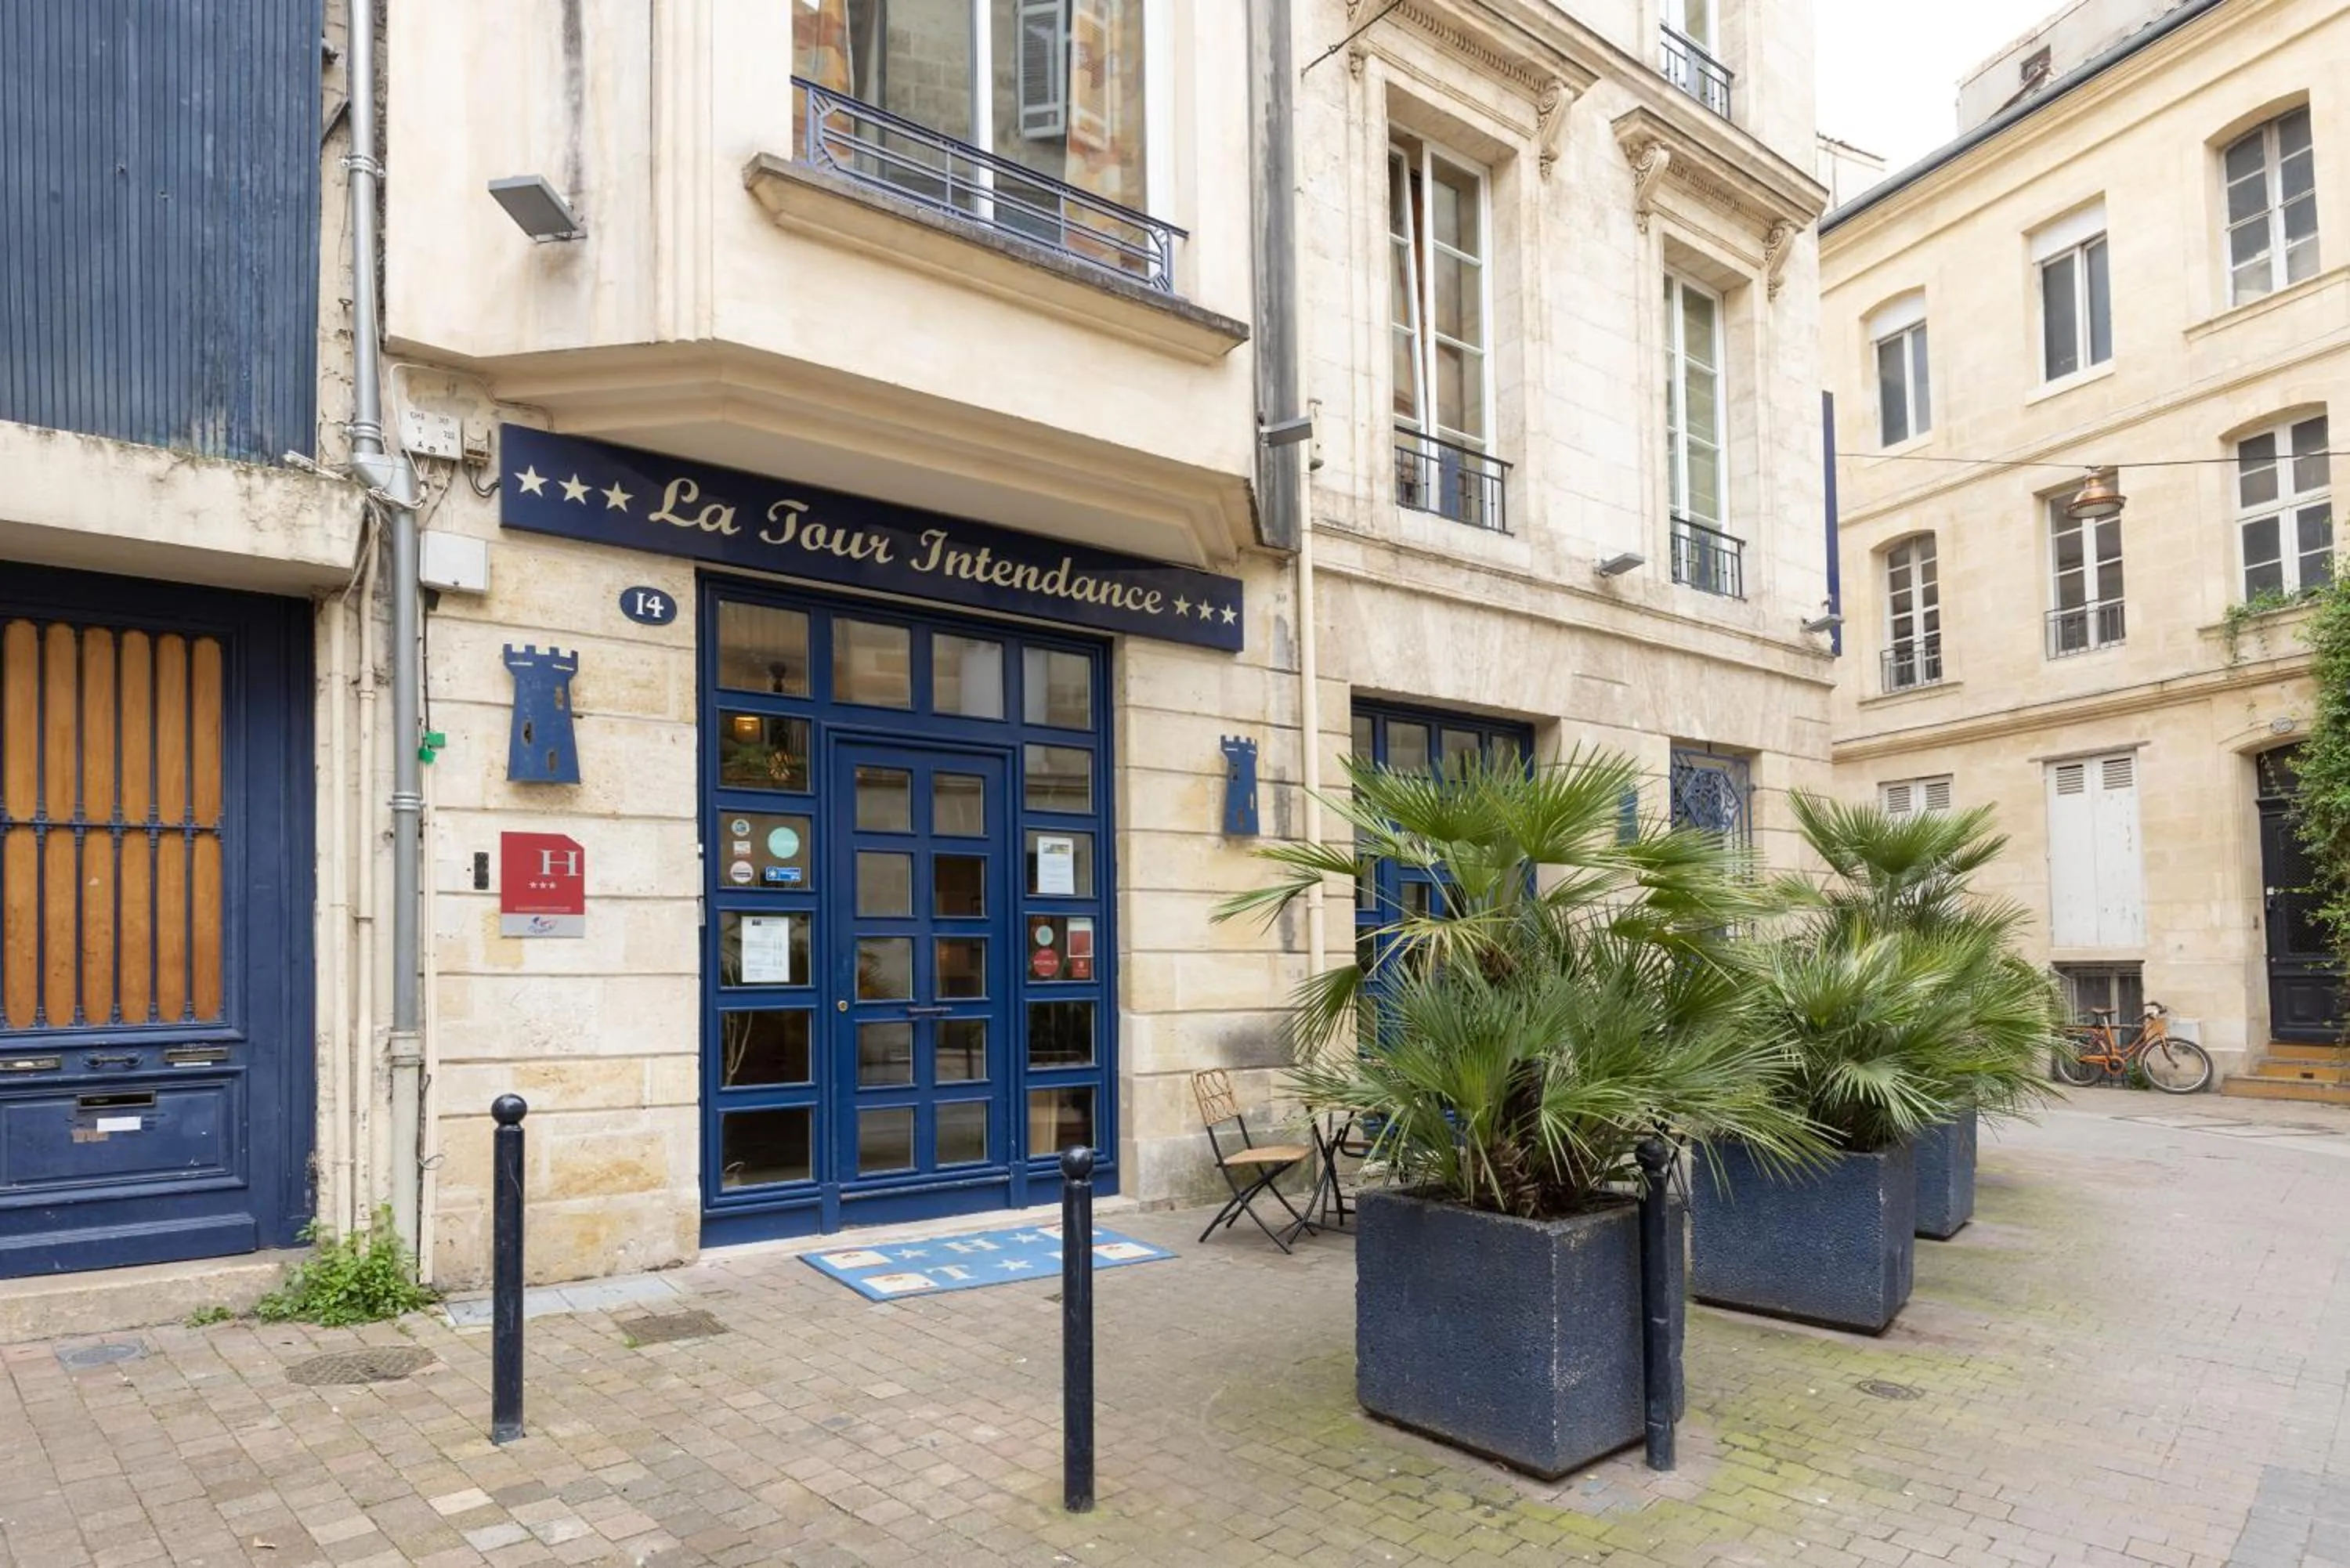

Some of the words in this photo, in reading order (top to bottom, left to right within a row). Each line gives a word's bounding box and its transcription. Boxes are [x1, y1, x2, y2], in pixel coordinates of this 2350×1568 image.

[648, 477, 742, 536] La
[759, 499, 894, 564] Tour
[909, 529, 1165, 615] Intendance
[635, 591, 665, 618] 14
[537, 850, 581, 876] H
